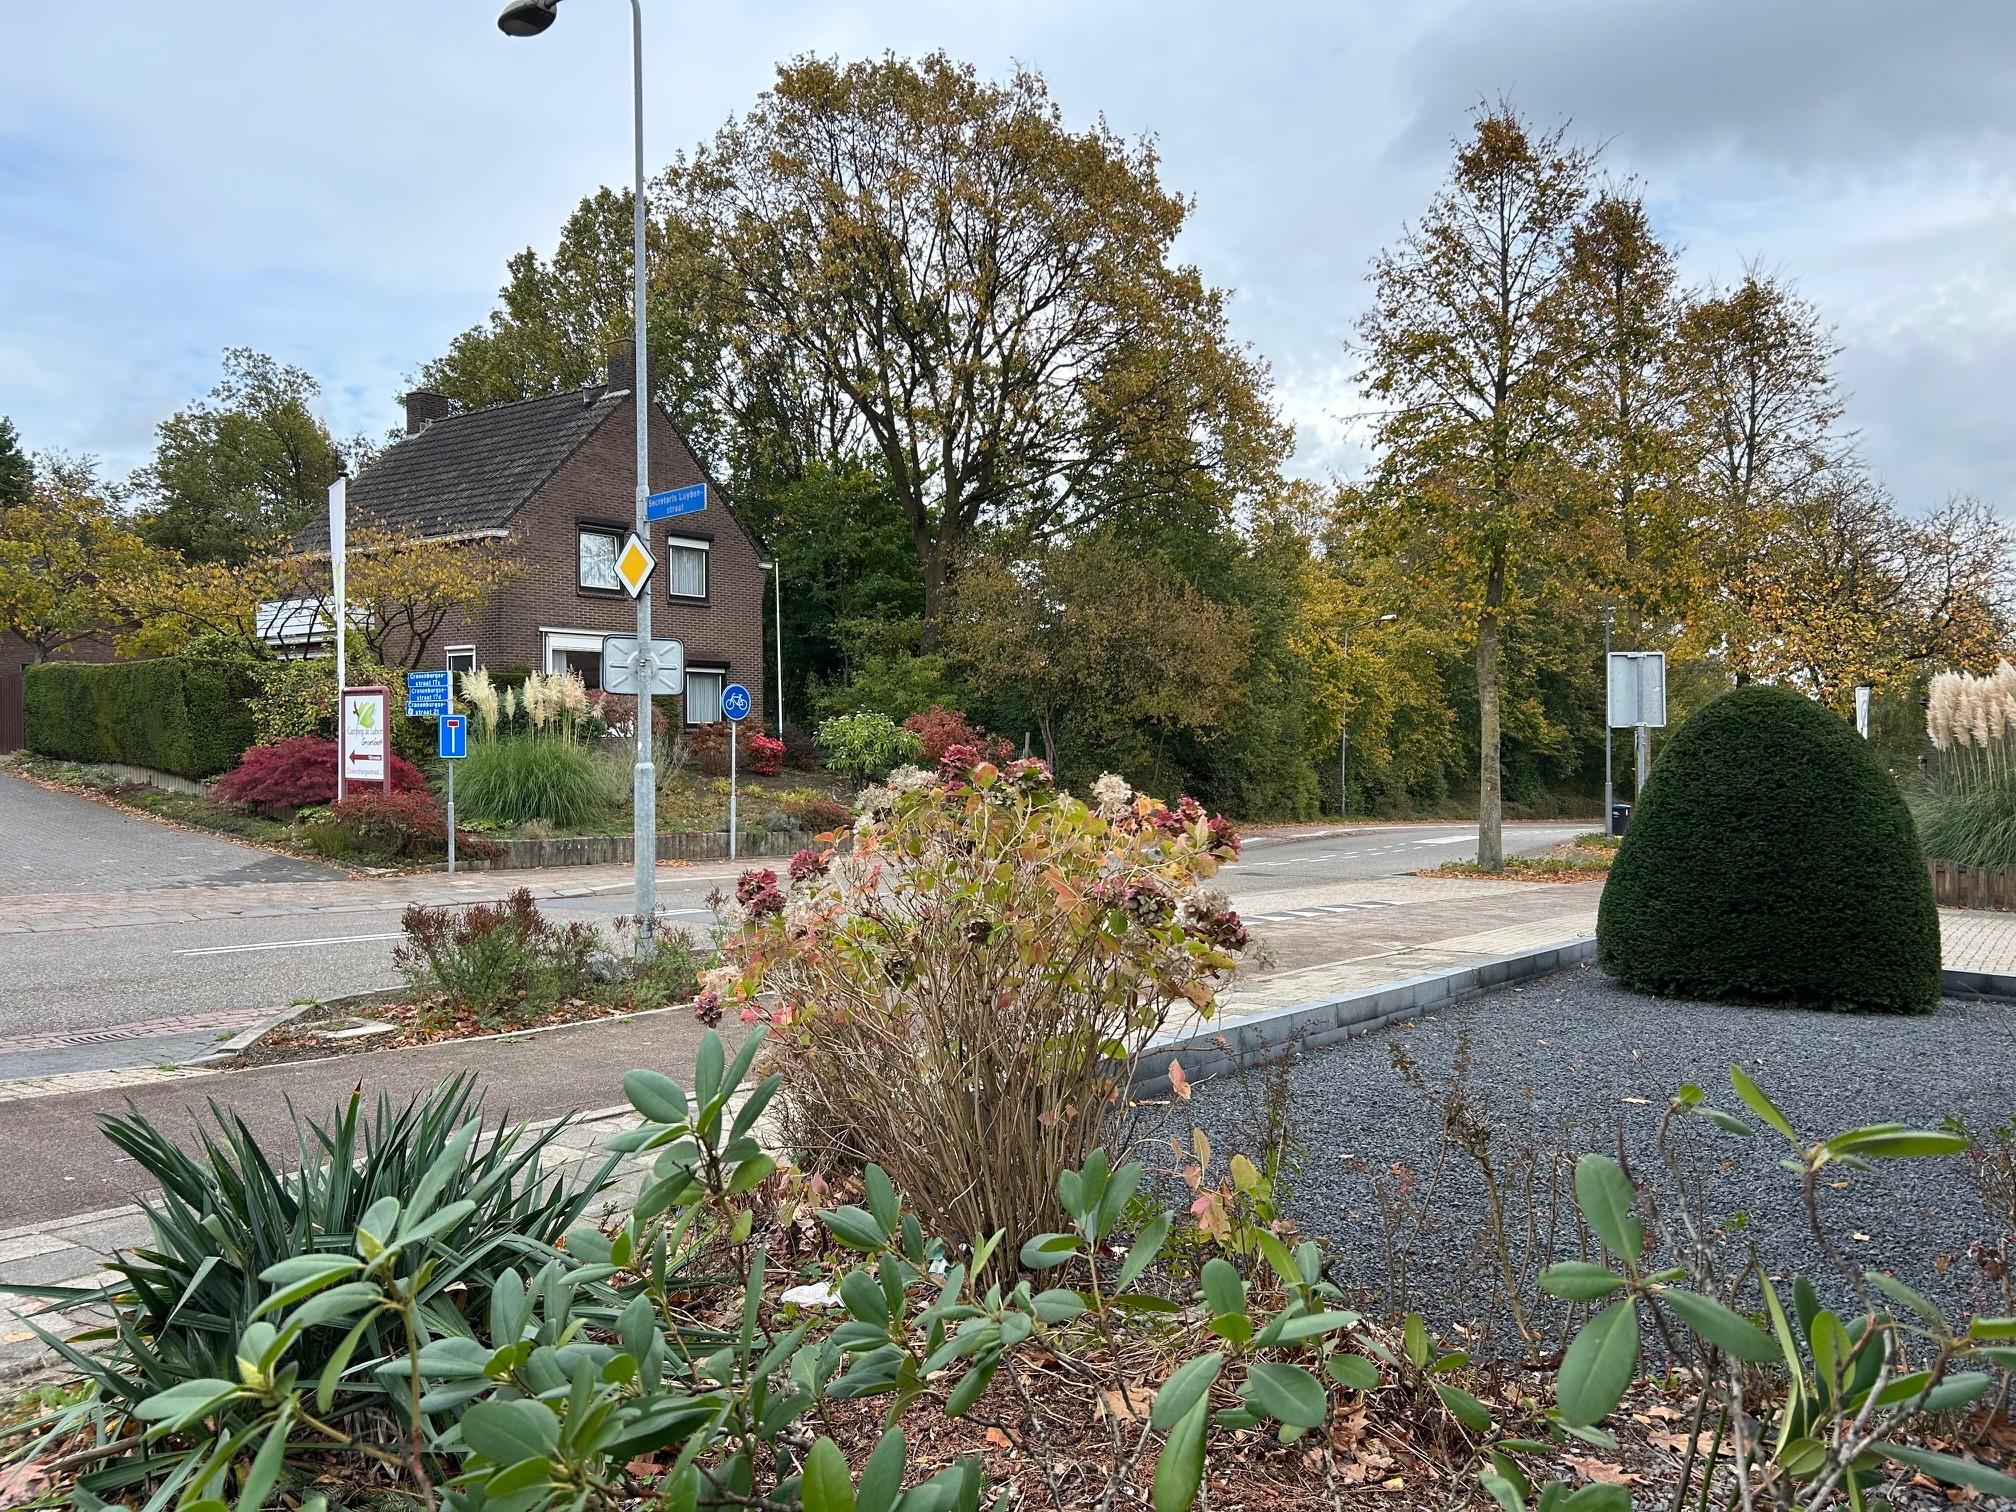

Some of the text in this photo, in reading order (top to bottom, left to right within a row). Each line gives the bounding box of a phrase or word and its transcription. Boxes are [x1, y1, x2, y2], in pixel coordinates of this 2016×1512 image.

[648, 489, 704, 508] Secretaris Luyben-
[666, 503, 684, 514] straat
[411, 687, 447, 695] Cranenburgse-
[408, 701, 447, 710] Cranenburgse-
